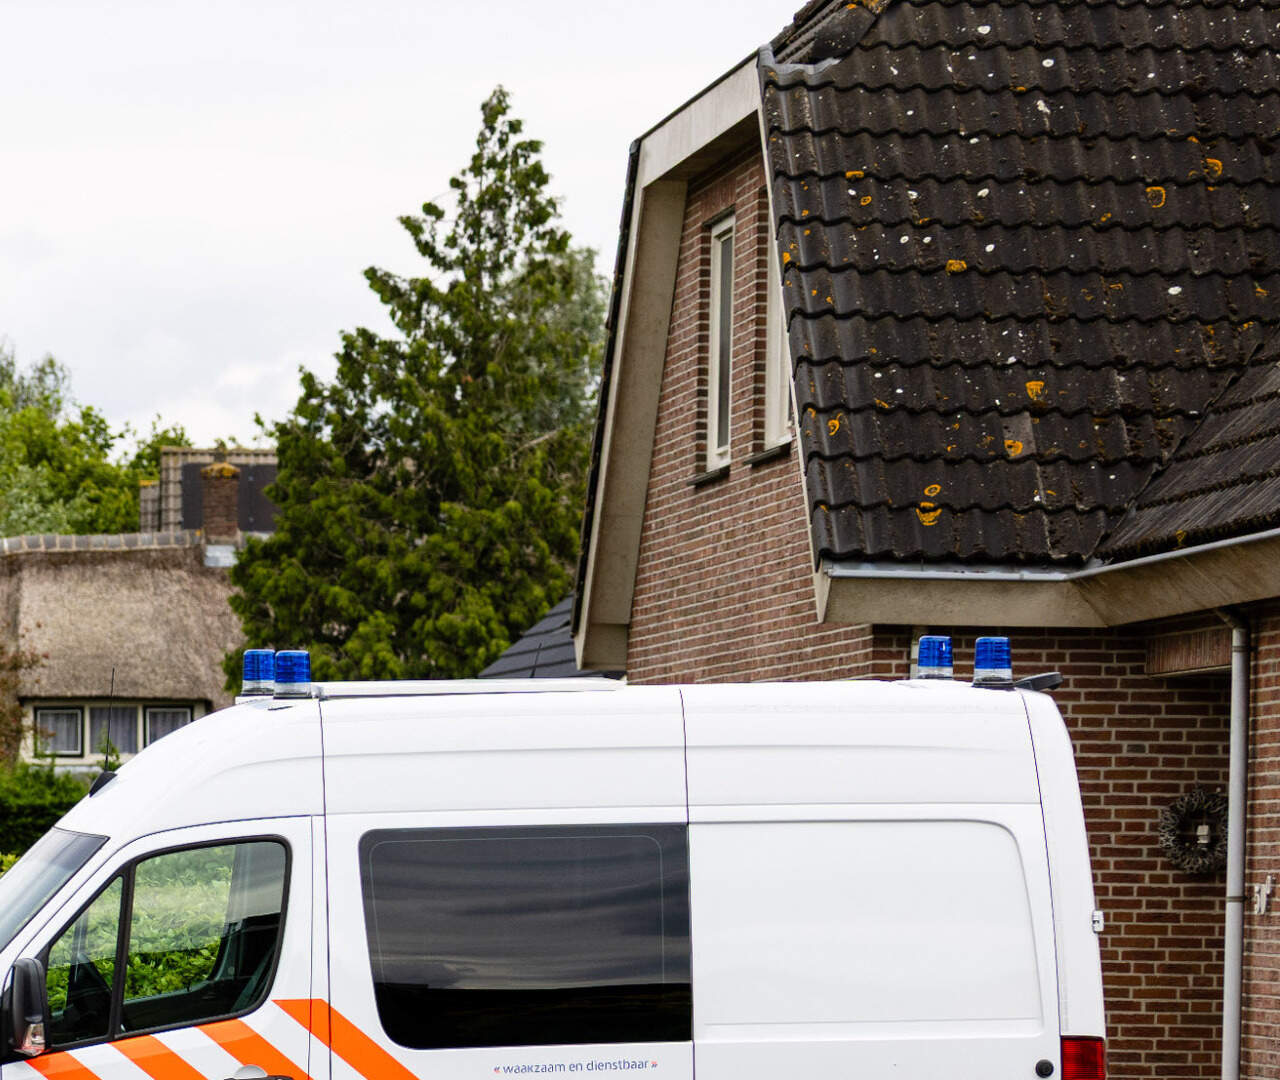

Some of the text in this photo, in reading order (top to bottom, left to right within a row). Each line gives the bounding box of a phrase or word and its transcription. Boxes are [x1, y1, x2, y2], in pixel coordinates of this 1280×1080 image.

[502, 1062, 566, 1074] waakzaam
[568, 1061, 583, 1072] en
[586, 1059, 649, 1072] dienstbaar
